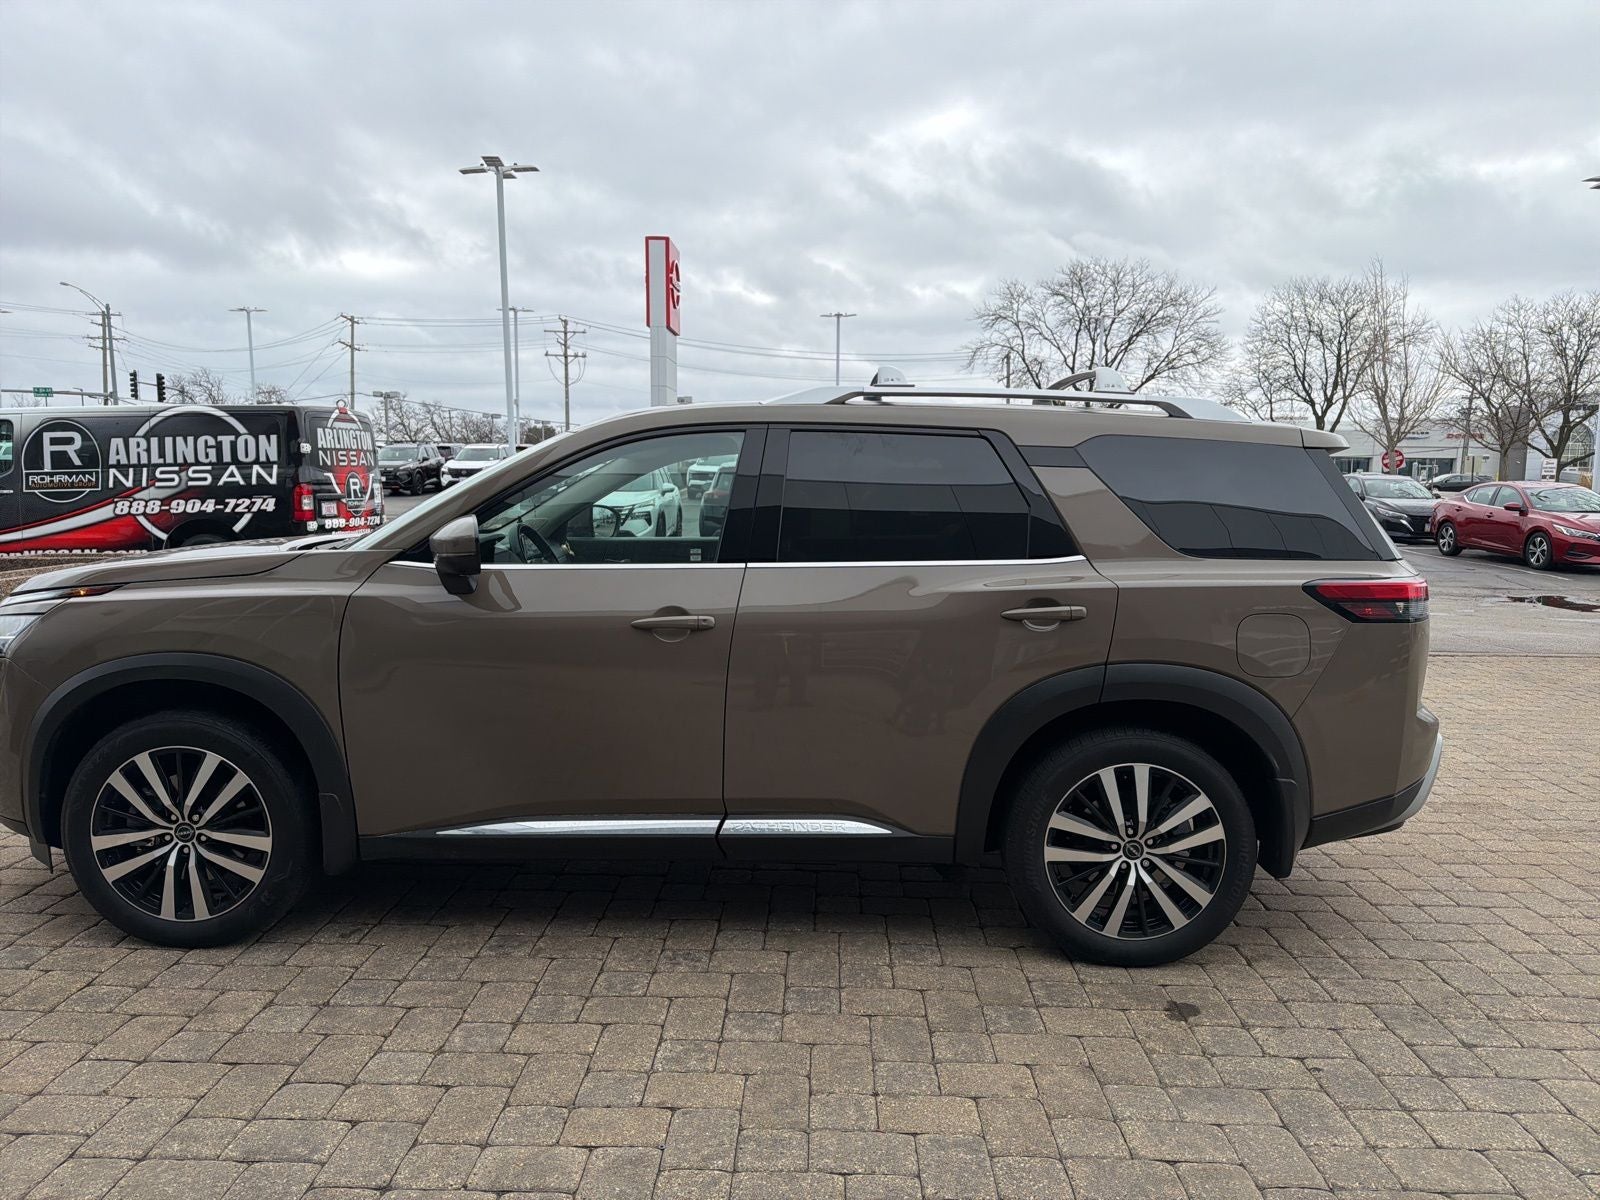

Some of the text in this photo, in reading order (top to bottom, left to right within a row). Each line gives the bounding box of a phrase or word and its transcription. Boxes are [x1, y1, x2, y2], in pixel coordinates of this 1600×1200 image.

[108, 434, 279, 465] ARLINGTON
[317, 428, 373, 451] ARLINGTON
[43, 431, 83, 471] R
[318, 450, 375, 467] NISSAN
[29, 472, 96, 485] ROHRMAN
[108, 464, 279, 488] NISSAN
[114, 498, 277, 514] 888-904-7274
[731, 822, 847, 832] PATHFINDER
